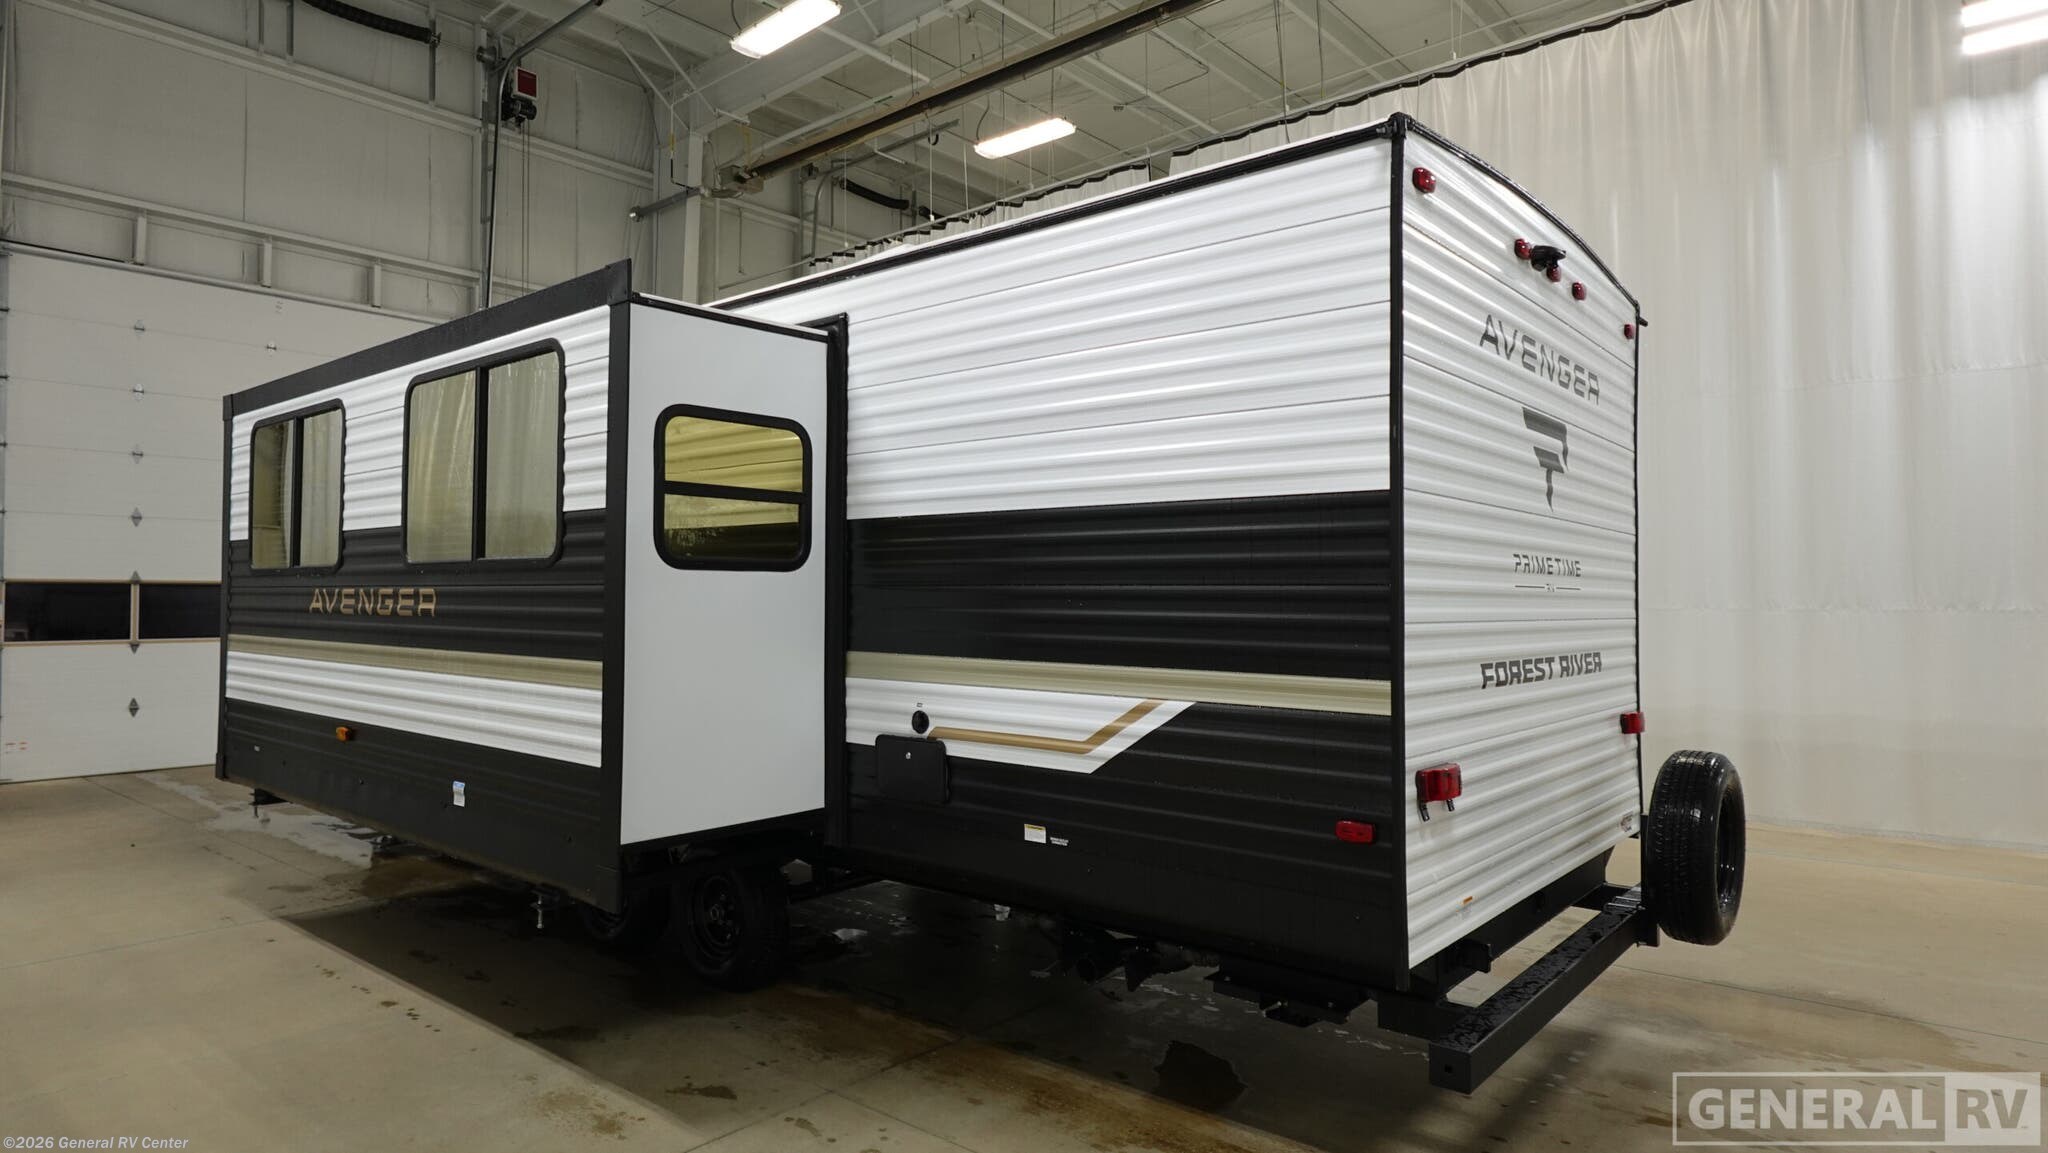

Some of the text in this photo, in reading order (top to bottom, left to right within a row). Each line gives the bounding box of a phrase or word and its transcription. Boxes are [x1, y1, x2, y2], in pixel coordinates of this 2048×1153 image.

[1480, 314, 1600, 405] AVENGER
[1513, 553, 1581, 577] PRIMETIME
[309, 588, 436, 616] AVENGER
[1480, 652, 1602, 689] FOREST RIVER
